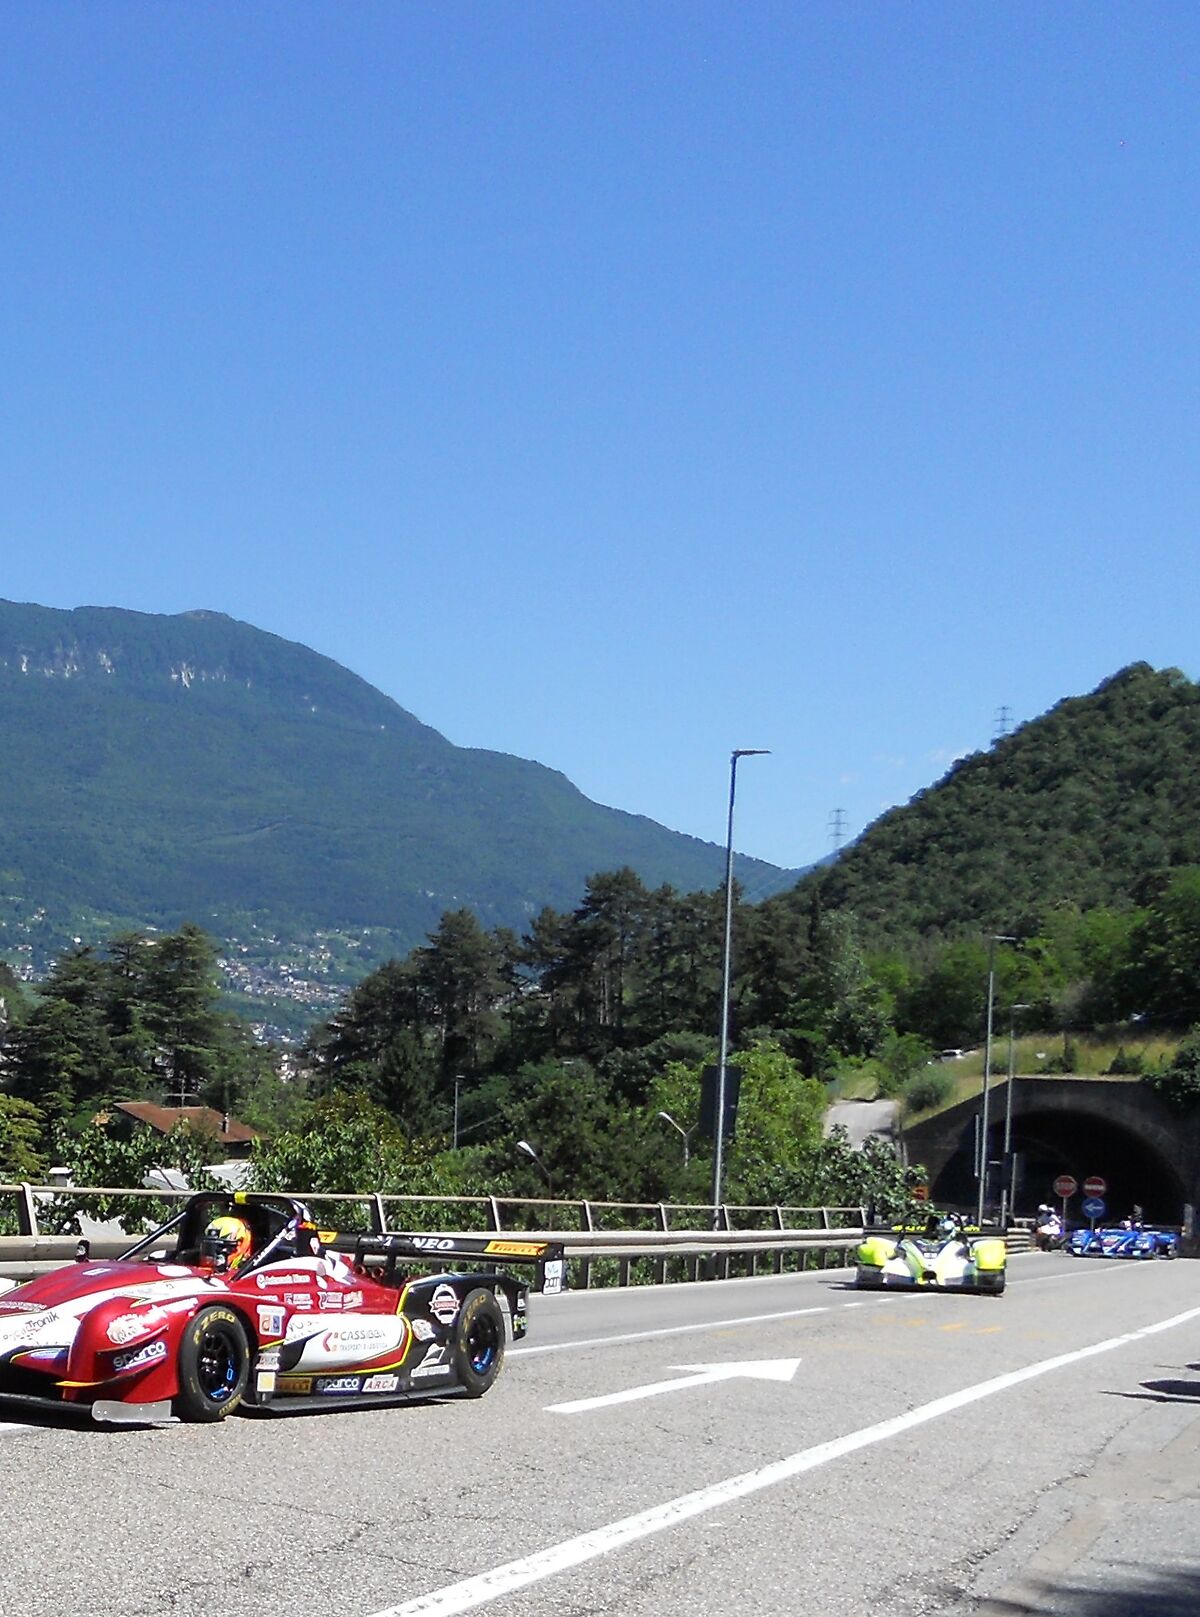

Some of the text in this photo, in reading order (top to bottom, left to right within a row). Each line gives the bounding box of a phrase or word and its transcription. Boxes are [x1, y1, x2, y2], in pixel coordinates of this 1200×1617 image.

[201, 1311, 235, 1331] ZERO
[113, 1341, 166, 1369] sparco
[316, 1377, 360, 1390] sparco
